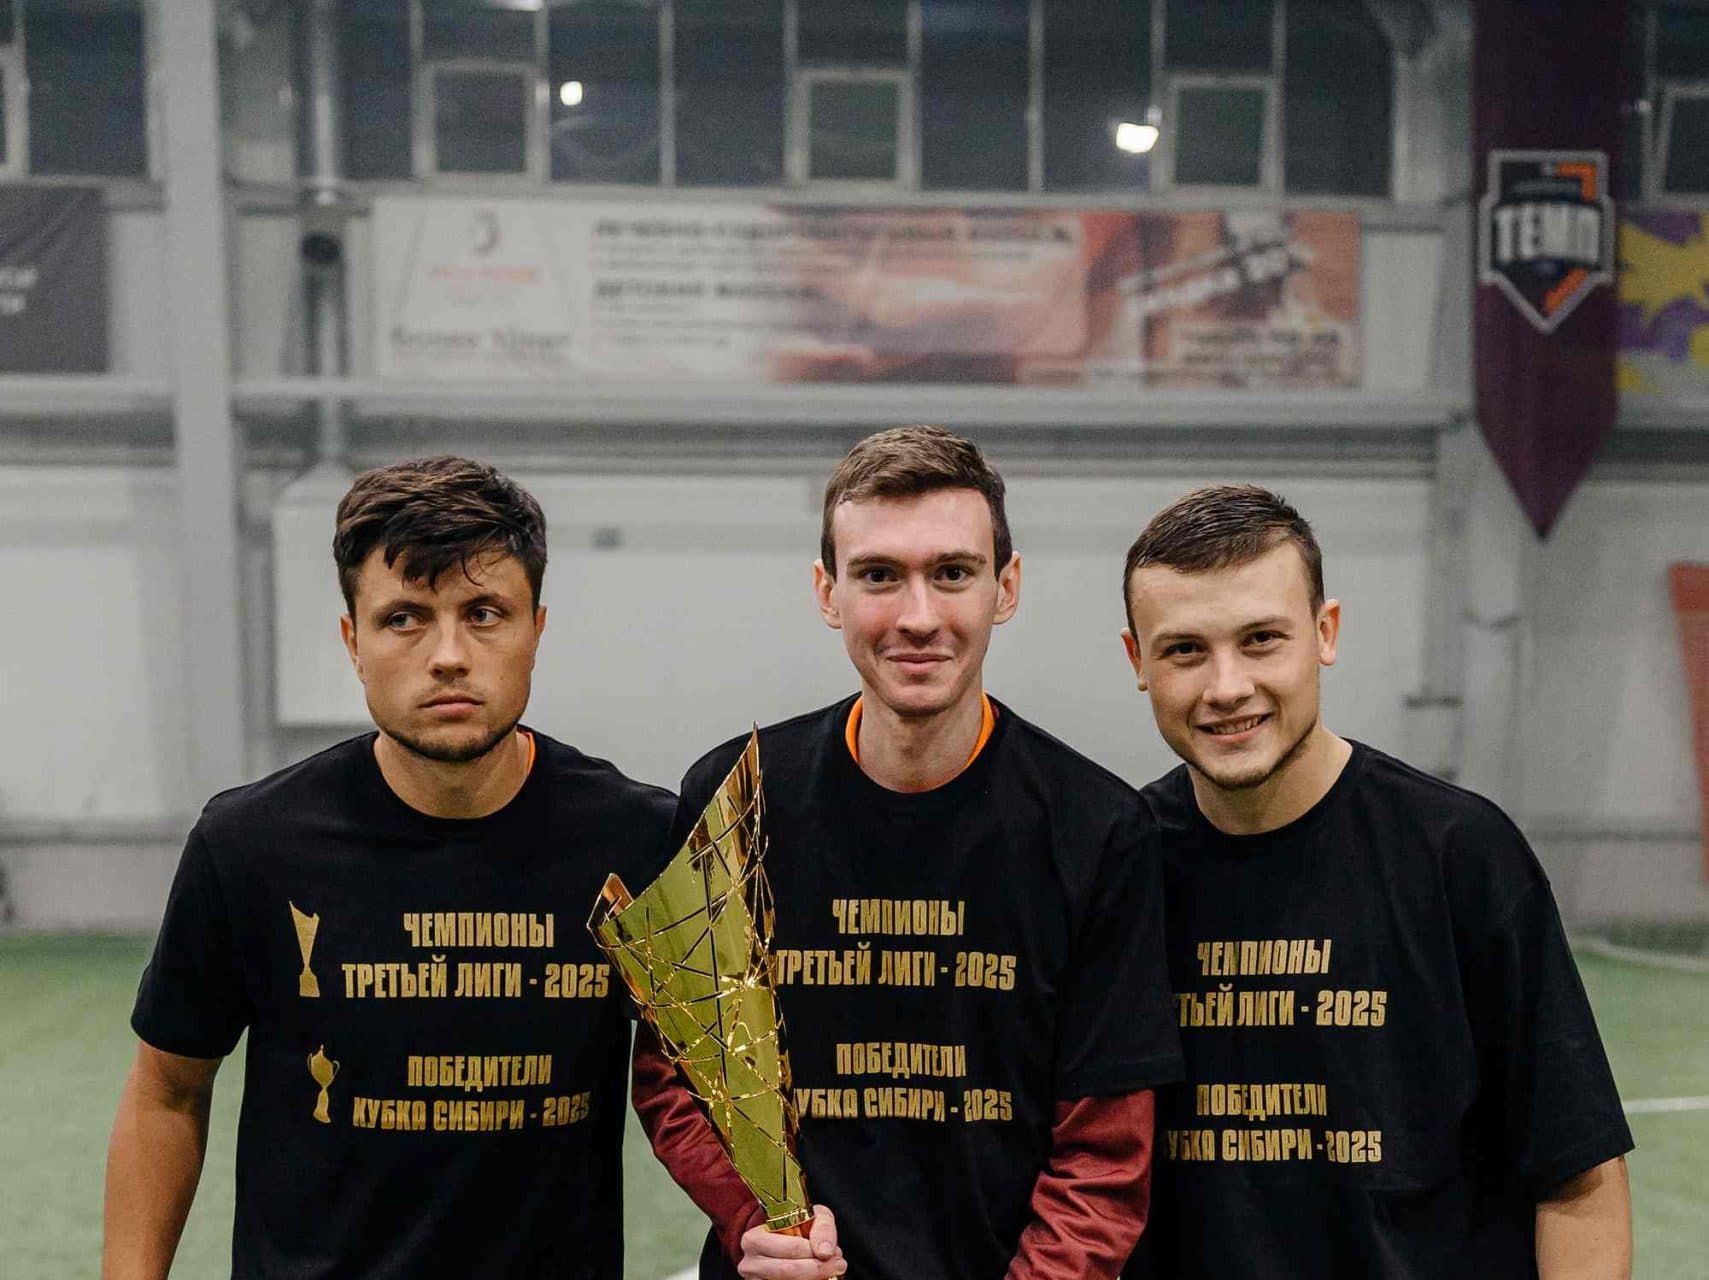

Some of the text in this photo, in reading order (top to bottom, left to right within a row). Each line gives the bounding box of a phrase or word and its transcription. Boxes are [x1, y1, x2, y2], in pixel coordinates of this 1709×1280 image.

[1496, 202, 1600, 264] ТЕМП
[403, 911, 555, 948] ЧЕМПИОНЫ
[833, 898, 966, 936] ЧЕМПИОНЫ
[342, 953, 448, 999] ТРЕТЬЕЙ
[454, 962, 522, 998] ЛИГИ
[544, 963, 611, 999] 2025
[776, 942, 871, 986] ТРЕТЬЕЙ
[878, 950, 936, 987] ЛИГИ
[955, 951, 1017, 991] 2025
[1197, 939, 1333, 976] ЧЕМПИОНЫ
[1178, 983, 1234, 1027] ТЬЕЙ
[1237, 990, 1296, 1026] ЛИГИ
[1316, 990, 1388, 1027] 2025
[408, 1055, 553, 1093] ПОБЕДИТЕЛИ
[836, 1042, 967, 1080] ПОБЕДИТЕЛИ
[352, 1096, 427, 1131] КУБКА
[433, 1099, 525, 1132] СИБИРИ
[543, 1091, 591, 1127] 2025
[793, 1088, 859, 1119] УБКА
[863, 1087, 946, 1123] СИБИРИ
[963, 1088, 1014, 1123] 2025
[1196, 1084, 1328, 1122] ПОБЕДИТЕЛИ
[1166, 1129, 1216, 1162] УБКА
[1222, 1128, 1313, 1162] СИБИРИ
[1325, 1130, 1382, 1164] 2025
